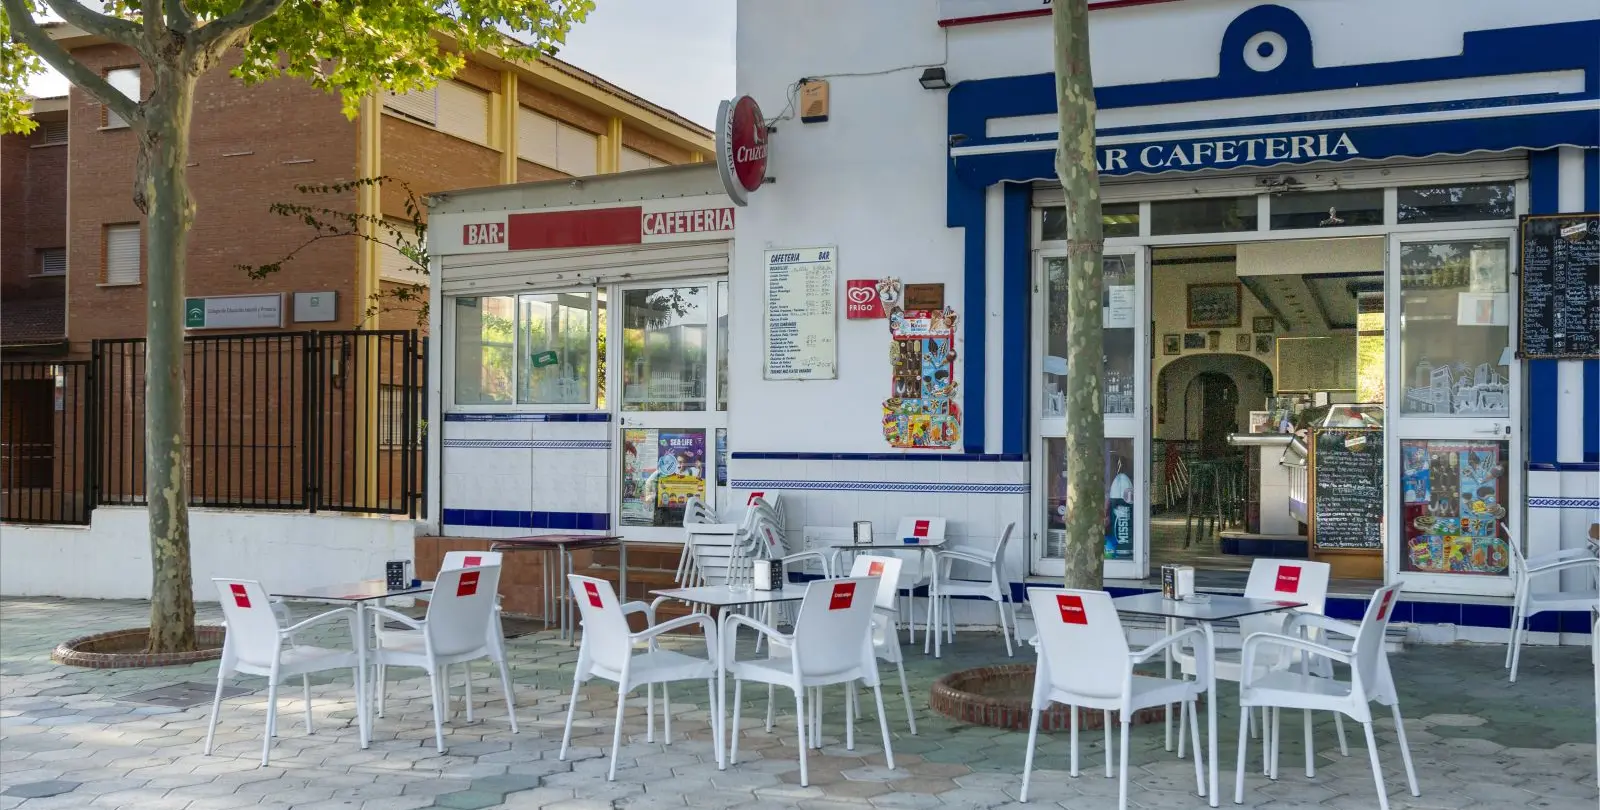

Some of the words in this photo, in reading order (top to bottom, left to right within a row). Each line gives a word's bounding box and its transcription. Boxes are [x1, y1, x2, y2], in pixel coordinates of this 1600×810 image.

[1140, 132, 1359, 168] CAFETERIA
[468, 223, 504, 244] BAR-
[643, 208, 734, 235] CAFETERIA
[770, 253, 800, 263] CAFETERIA
[818, 251, 830, 260] BAR
[670, 438, 682, 446] SEA
[682, 438, 693, 446] LIFE
